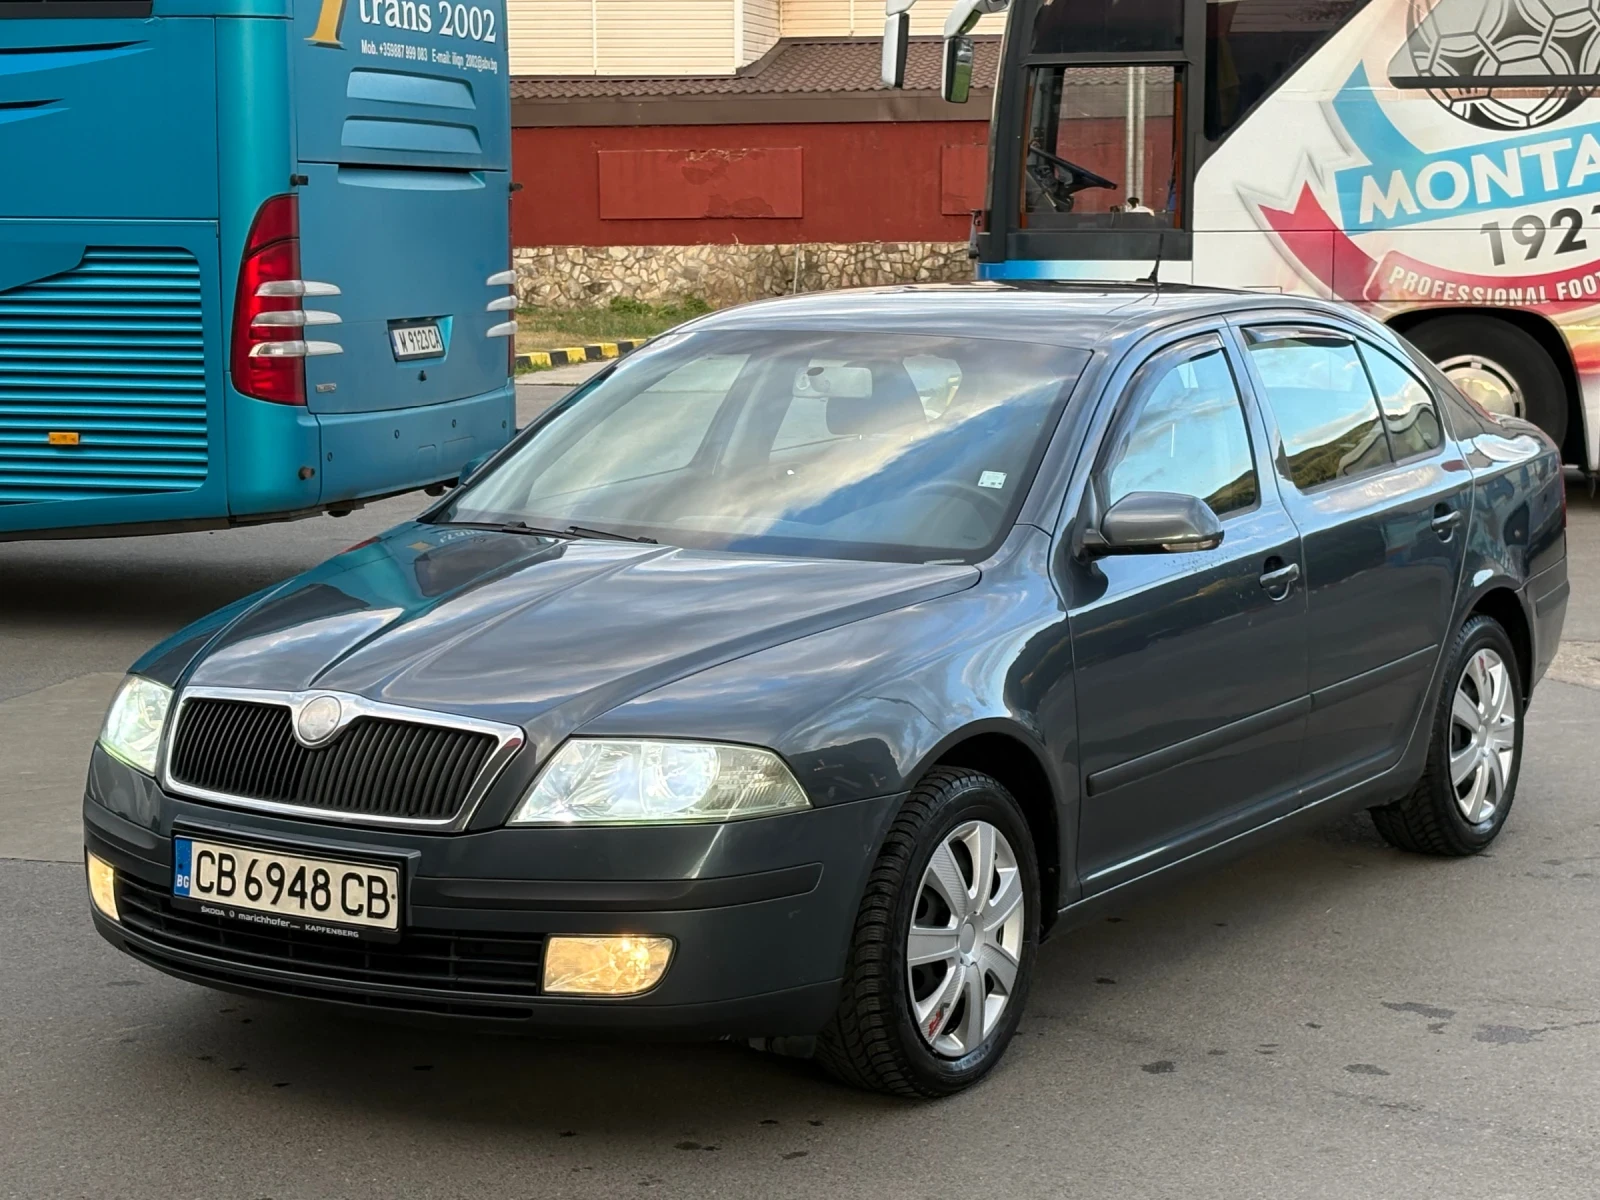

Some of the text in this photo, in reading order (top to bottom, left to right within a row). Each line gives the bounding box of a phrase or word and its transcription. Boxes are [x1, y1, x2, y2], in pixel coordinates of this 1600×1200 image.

[359, 0, 432, 33] trans
[438, 1, 497, 43] 2002
[361, 39, 378, 55] Mob.
[1359, 133, 1600, 224] MONTA
[1480, 204, 1600, 267] 192
[1388, 266, 1550, 307] PROFESSIONAL
[176, 873, 190, 889] BG
[195, 850, 390, 920] CB 6948 CB
[304, 924, 359, 938] KAPFENBERG
